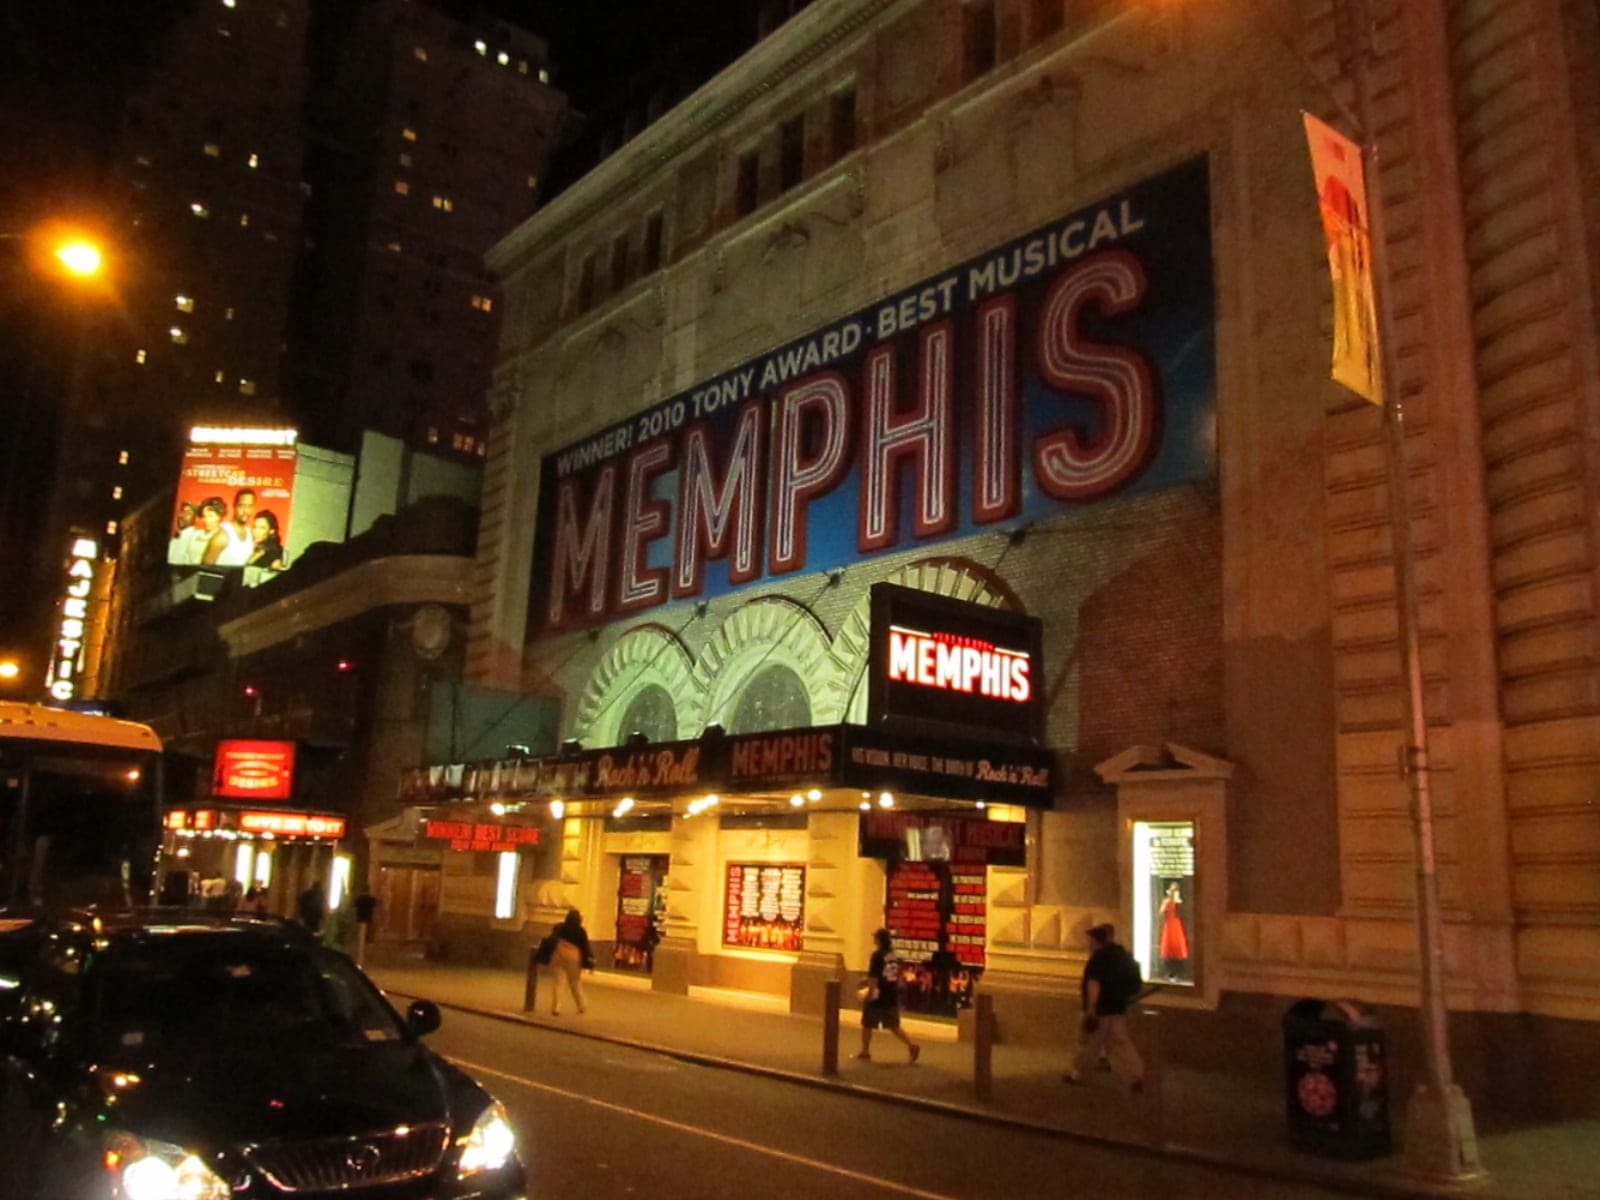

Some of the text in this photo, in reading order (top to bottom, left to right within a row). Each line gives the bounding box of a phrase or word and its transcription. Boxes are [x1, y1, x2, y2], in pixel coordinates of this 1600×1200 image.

[557, 199, 1144, 475] WINNER! 2010 TONY AWARD BEST MUSICAL
[549, 247, 1166, 628] MEMPHIS
[226, 476, 283, 488] DESIRE
[51, 539, 97, 700] MAJESTIC
[888, 631, 1031, 702] MEMPHIS
[732, 733, 833, 777] MEMPHIS
[726, 866, 741, 944] MEMPHIS
